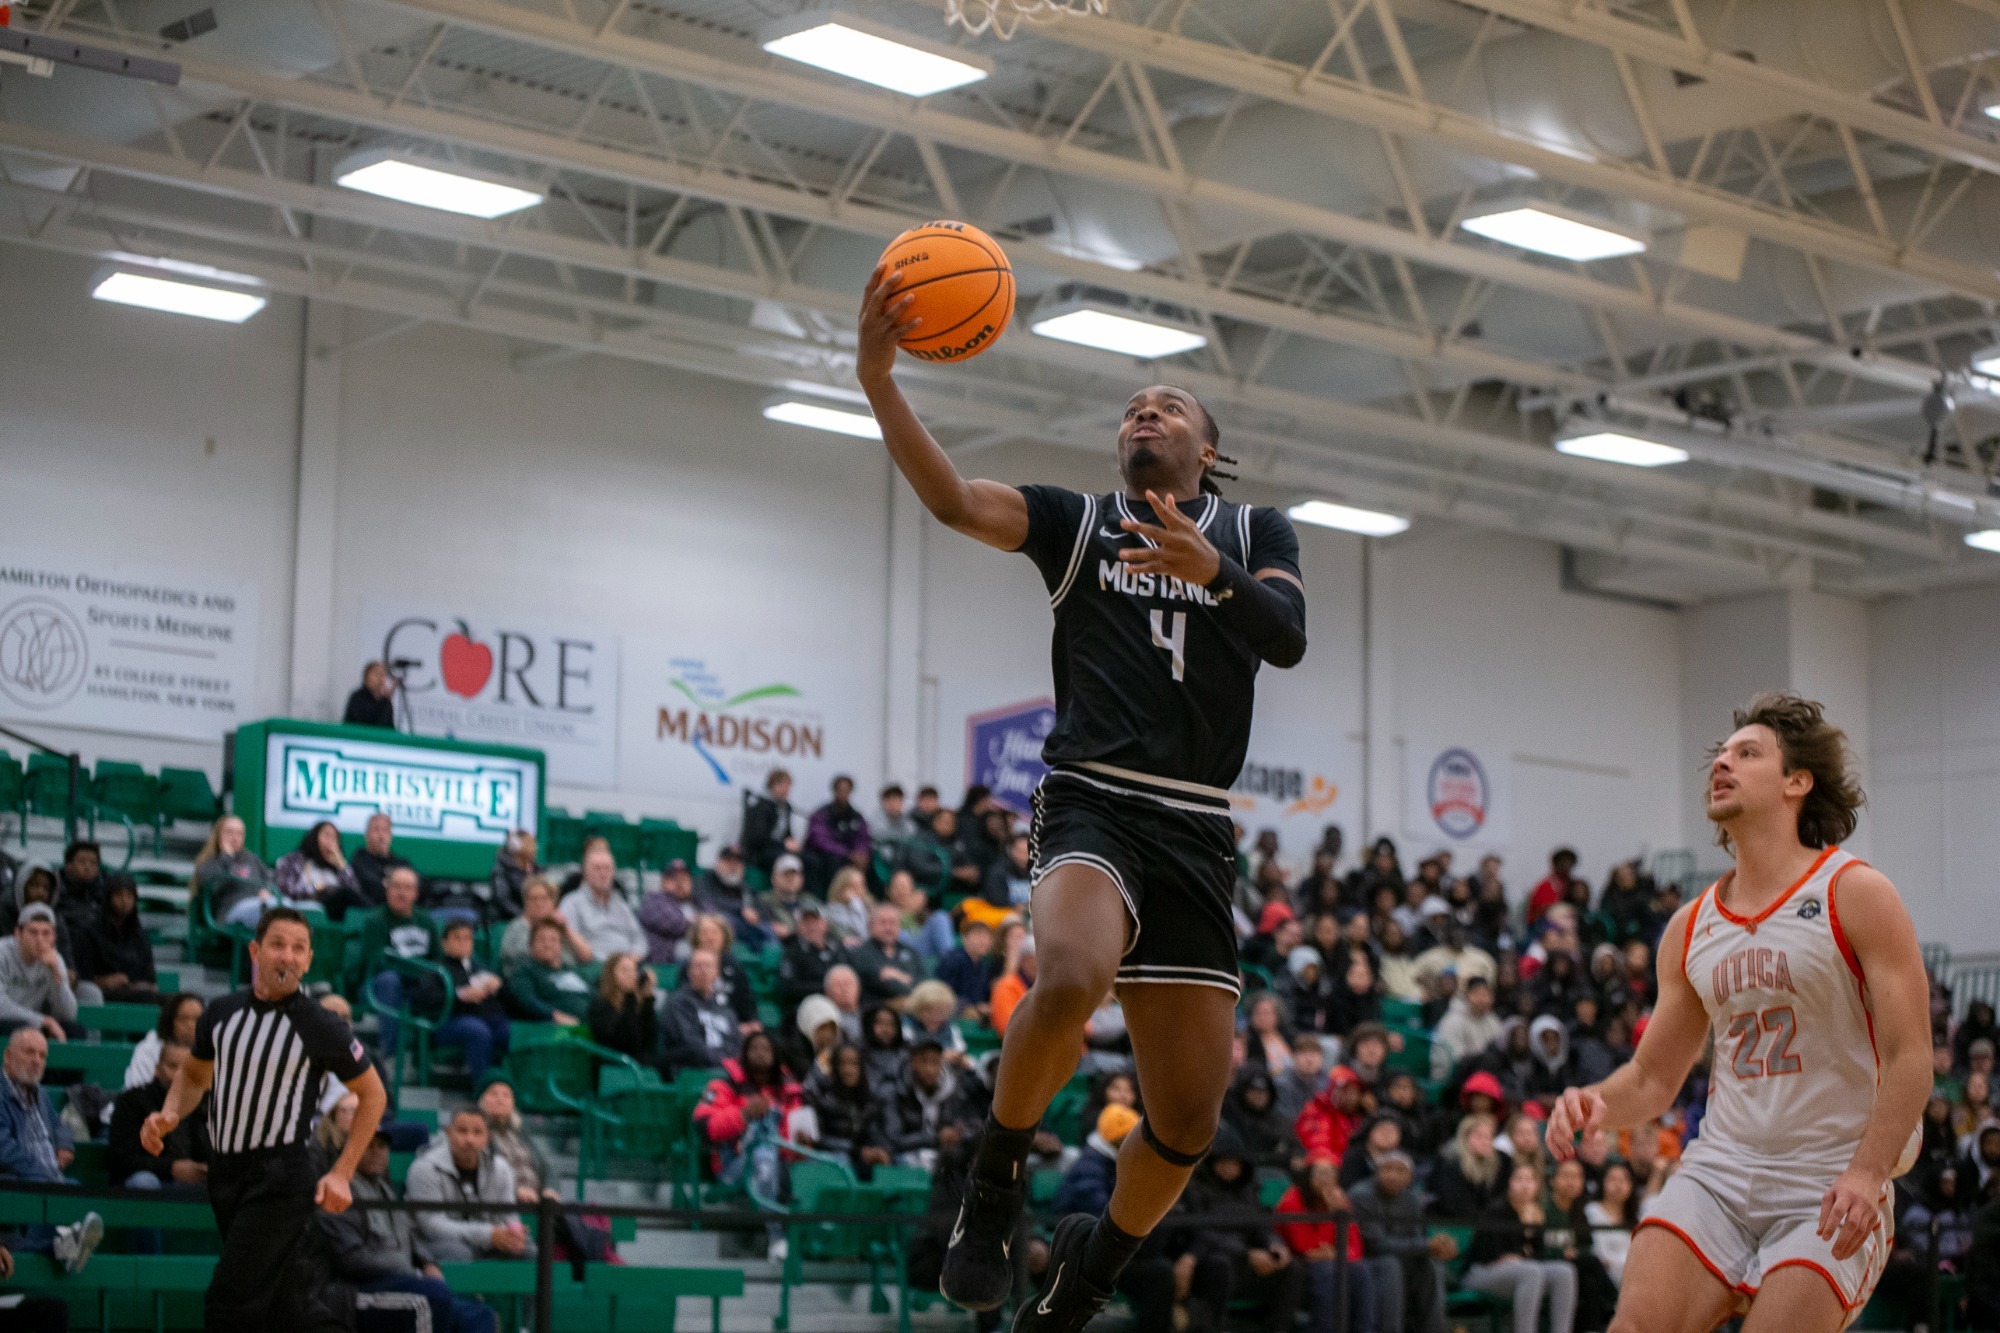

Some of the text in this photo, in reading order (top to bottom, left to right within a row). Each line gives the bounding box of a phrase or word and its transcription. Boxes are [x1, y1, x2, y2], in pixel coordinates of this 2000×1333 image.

[0, 567, 70, 592] AMILTON
[1150, 608, 1187, 682] 4
[657, 704, 822, 759] MADISON
[293, 759, 511, 820] MORRISVILLE
[1712, 947, 1798, 1006] UTICA
[1728, 1006, 1802, 1081] 22
